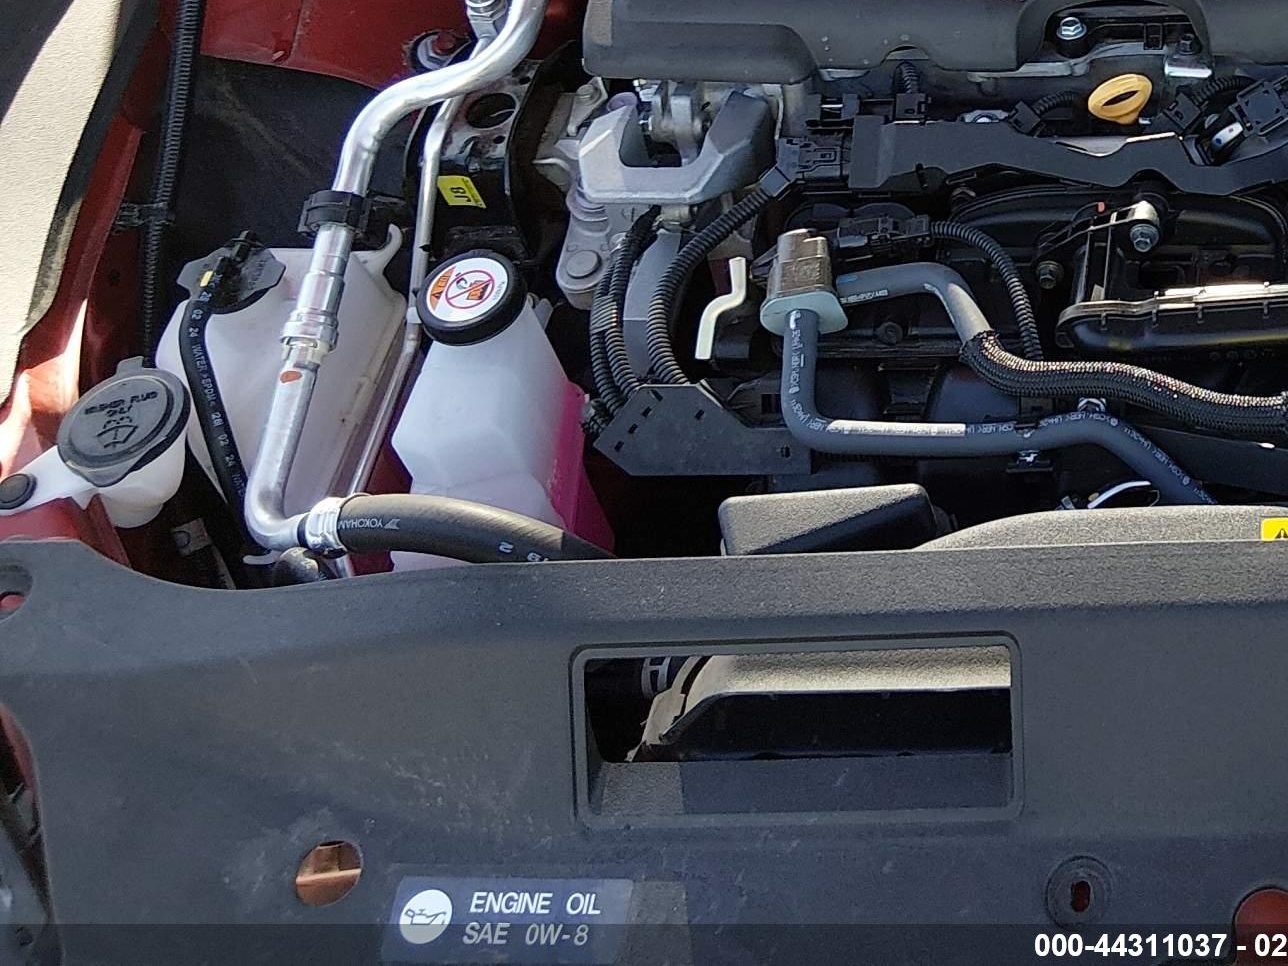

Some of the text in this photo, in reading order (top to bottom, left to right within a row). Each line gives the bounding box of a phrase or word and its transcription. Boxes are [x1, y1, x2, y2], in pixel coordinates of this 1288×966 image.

[469, 890, 601, 915] ENGINE OIL
[462, 922, 589, 946] SAE 0W-8
